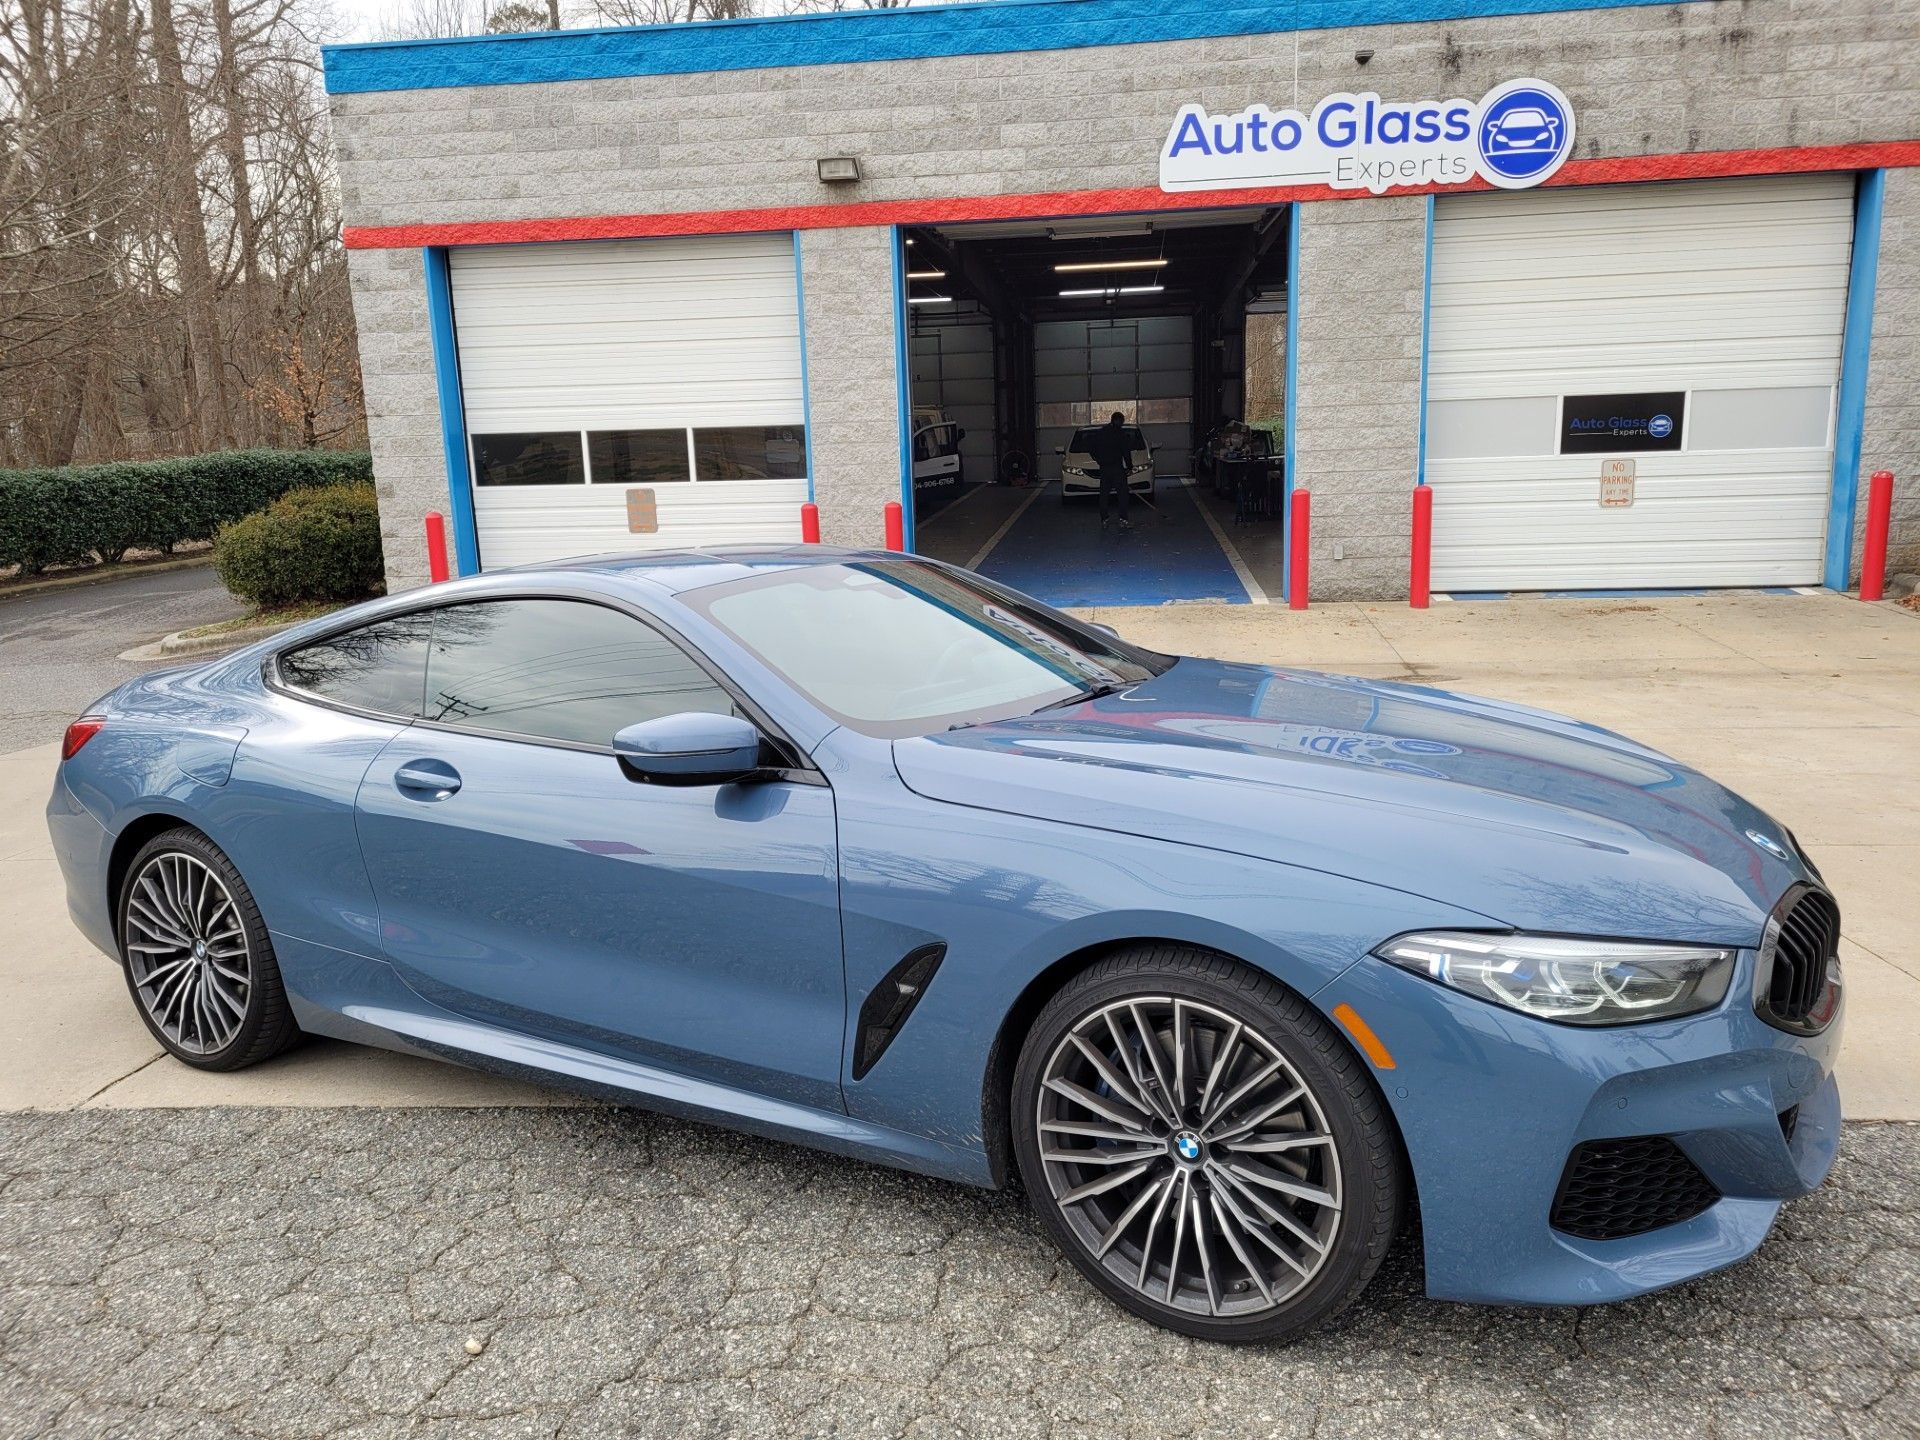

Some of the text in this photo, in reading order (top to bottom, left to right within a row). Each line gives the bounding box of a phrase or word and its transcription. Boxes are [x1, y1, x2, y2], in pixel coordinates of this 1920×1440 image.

[1168, 100, 1471, 158] Auto Glass
[1337, 154, 1467, 184] Experts
[1570, 416, 1648, 429] Auto Glass
[1613, 428, 1648, 436] Experts
[1612, 463, 1625, 472] NO
[1603, 475, 1633, 485] PARKING
